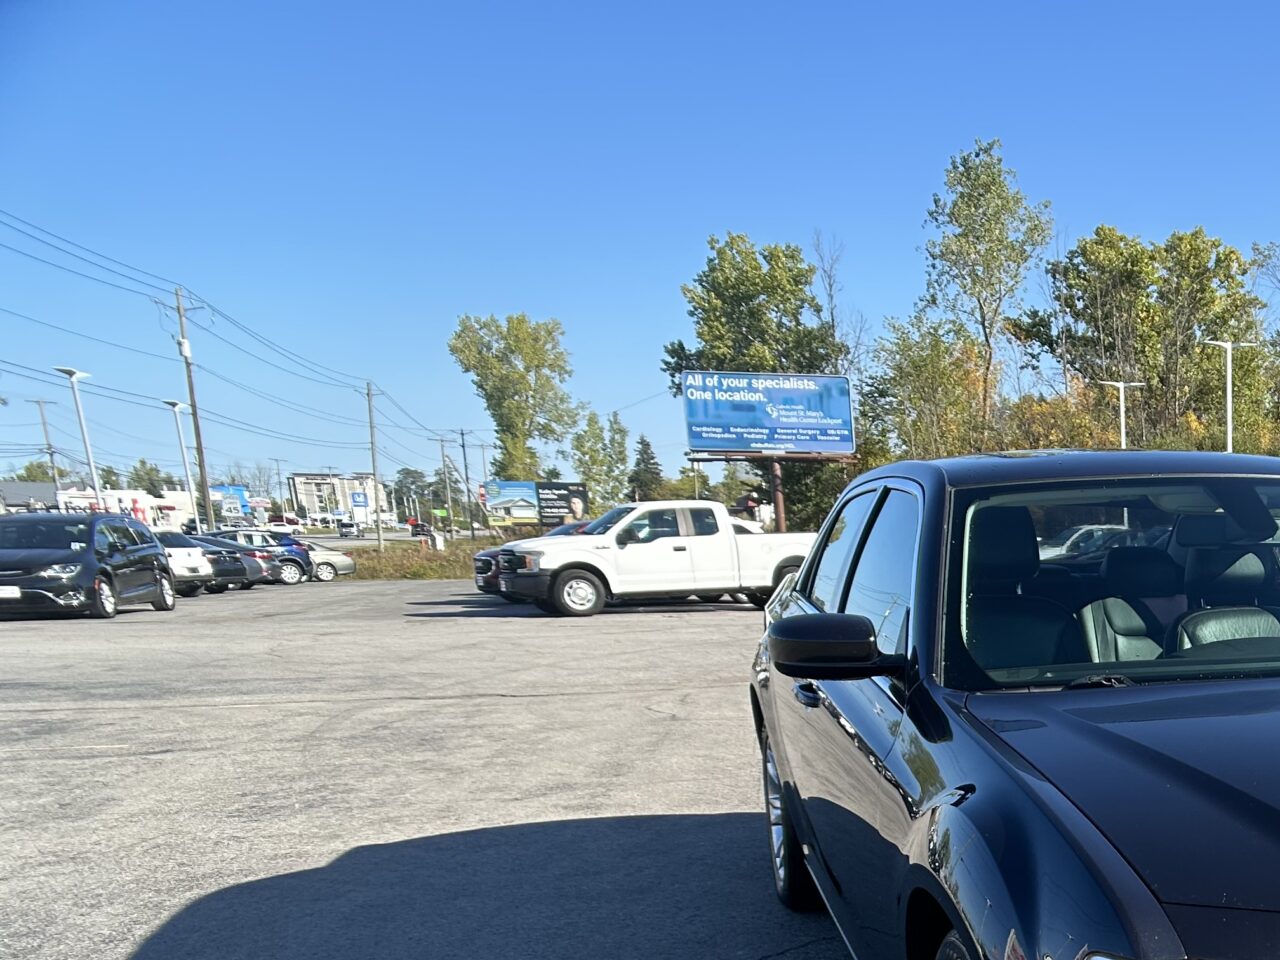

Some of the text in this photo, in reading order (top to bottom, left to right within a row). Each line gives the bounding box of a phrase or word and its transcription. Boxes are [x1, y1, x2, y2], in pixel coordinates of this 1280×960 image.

[686, 374, 819, 390] All of your specialists.
[687, 388, 768, 402] One location.
